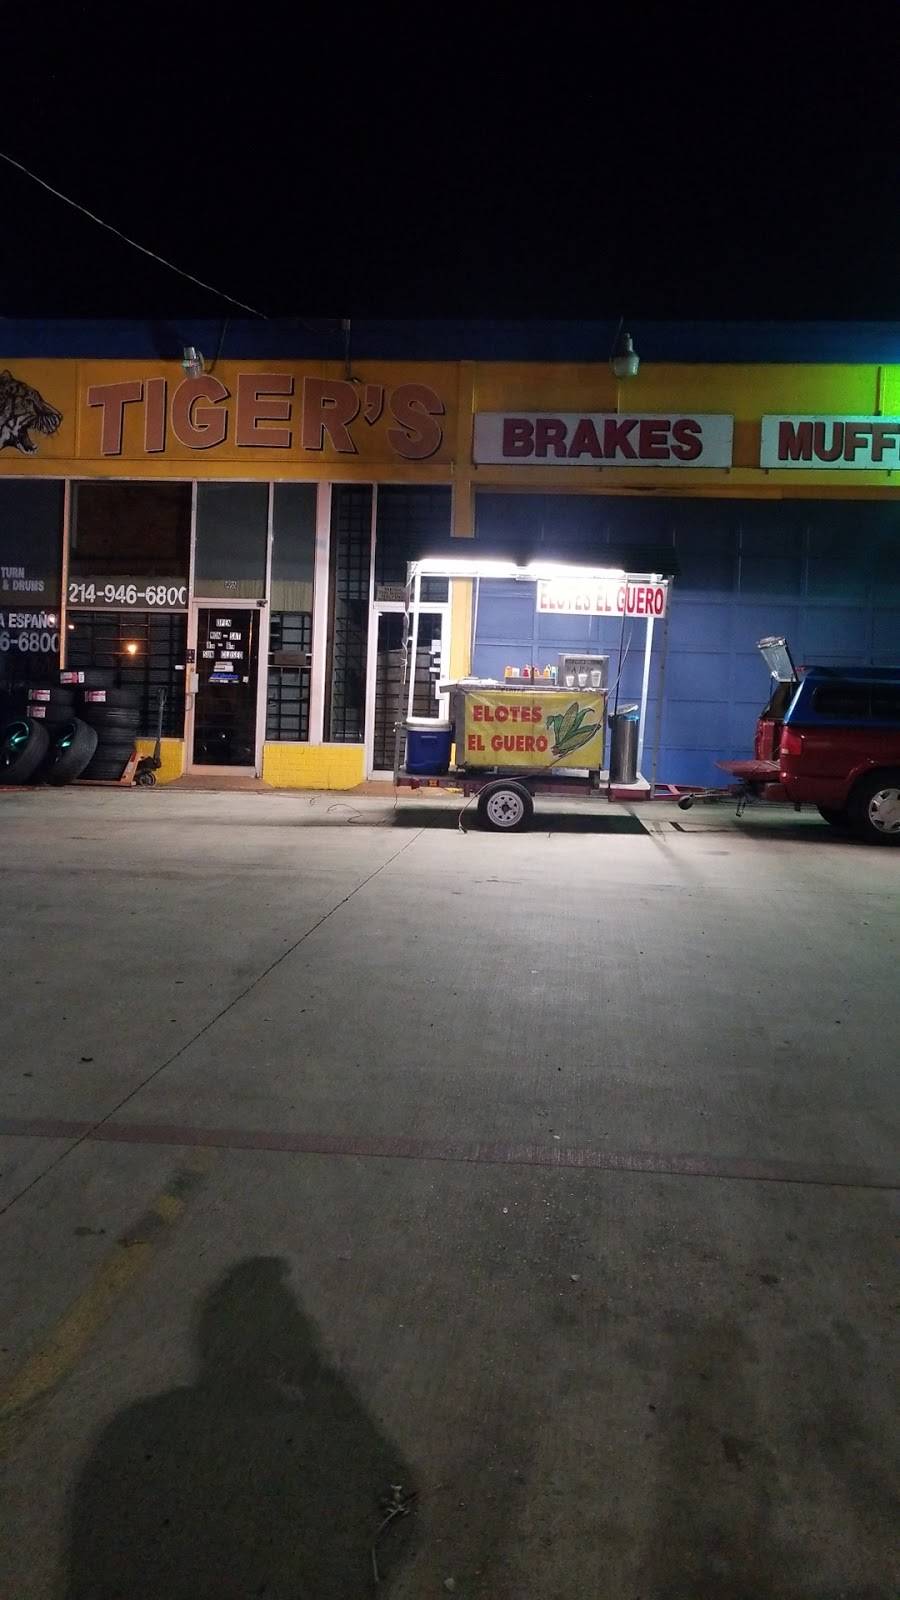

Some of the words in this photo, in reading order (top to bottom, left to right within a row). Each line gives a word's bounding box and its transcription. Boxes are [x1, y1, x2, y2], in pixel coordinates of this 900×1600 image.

[87, 373, 446, 460] TIGER'S
[502, 418, 704, 461] BRAKES
[778, 421, 900, 463] MUFF
[1, 566, 25, 578] TURN
[2, 580, 9, 591] &
[12, 580, 45, 592] DRUMS
[596, 585, 612, 612] EL
[617, 586, 665, 616] GUERO
[216, 618, 232, 627] OPEN
[472, 705, 543, 723] ELOTES
[467, 734, 485, 752] EL
[491, 734, 549, 753] GUERO
